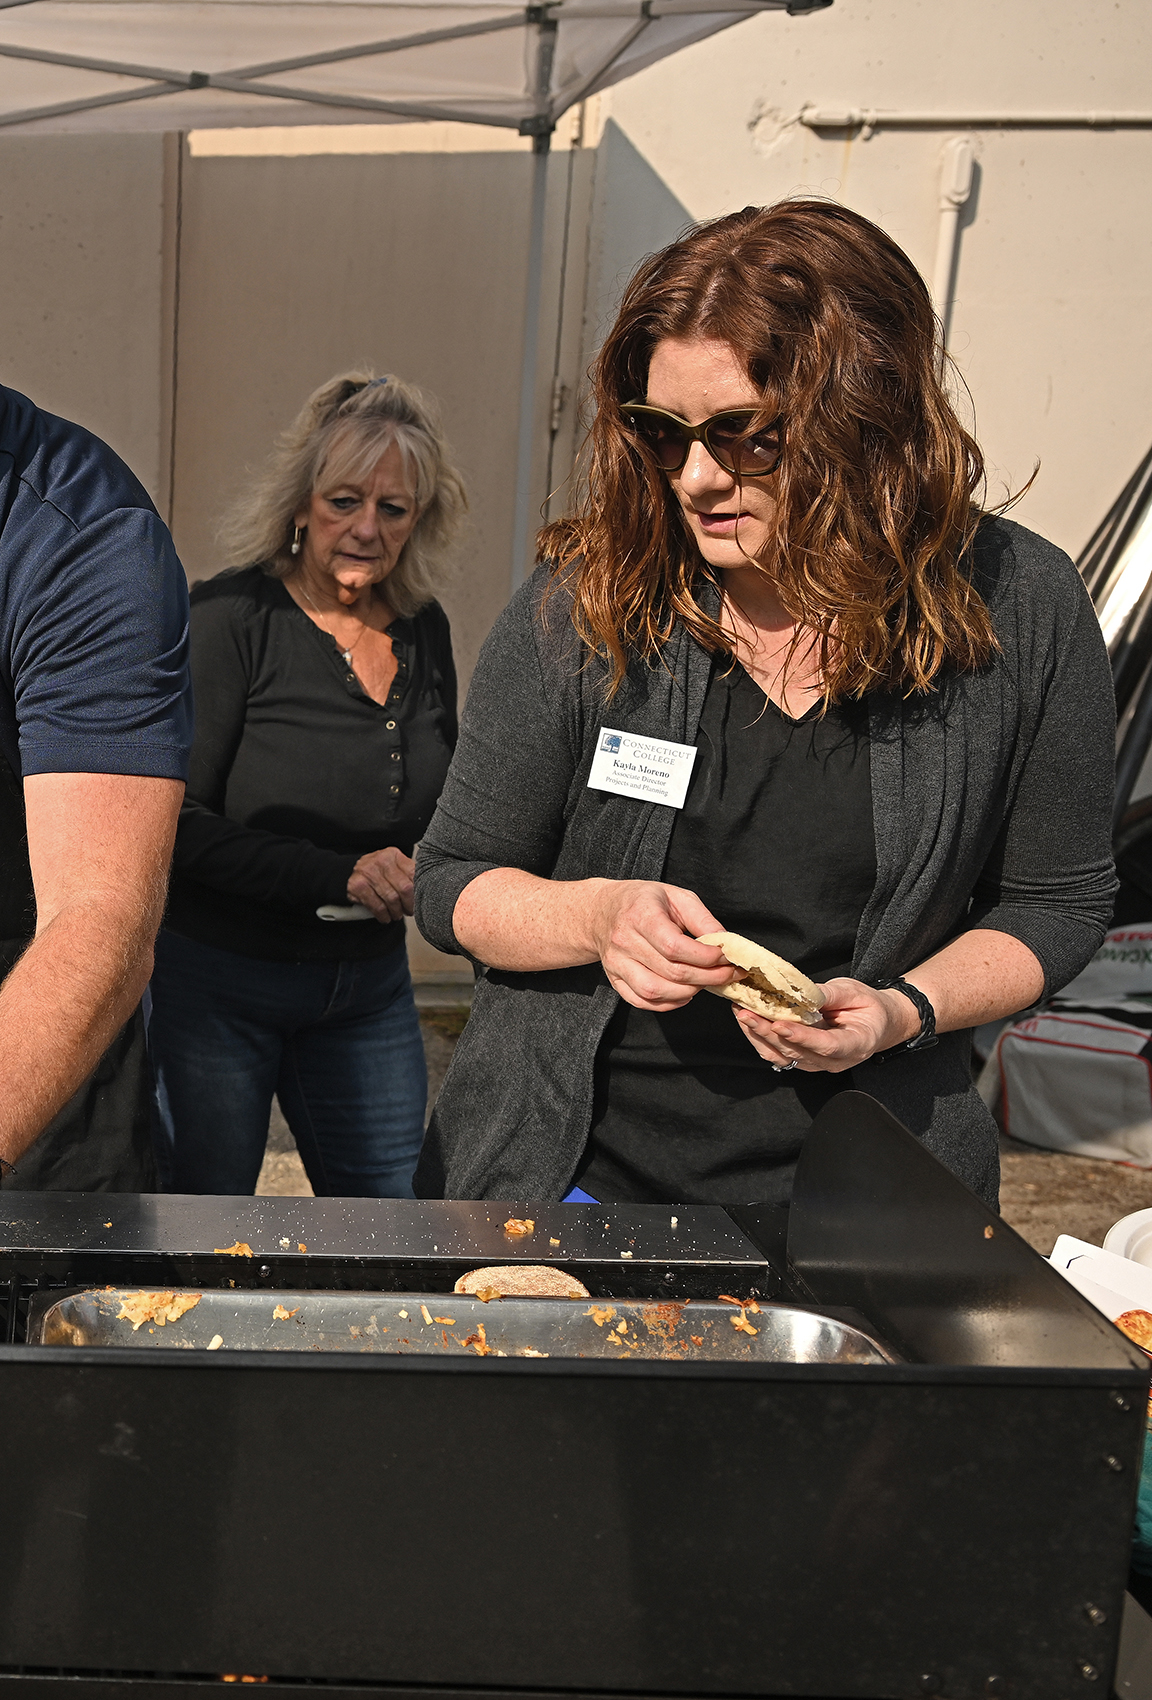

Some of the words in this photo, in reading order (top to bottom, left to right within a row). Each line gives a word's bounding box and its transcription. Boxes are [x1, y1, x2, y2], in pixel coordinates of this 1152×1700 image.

[623, 739, 691, 759] CONNECTICUT
[633, 750, 675, 765] COLLEGE
[613, 759, 636, 771] Kayla
[638, 765, 670, 779] Moreno
[605, 776, 629, 787] Projects
[642, 785, 669, 797] Planning
[641, 776, 666, 786] Director
